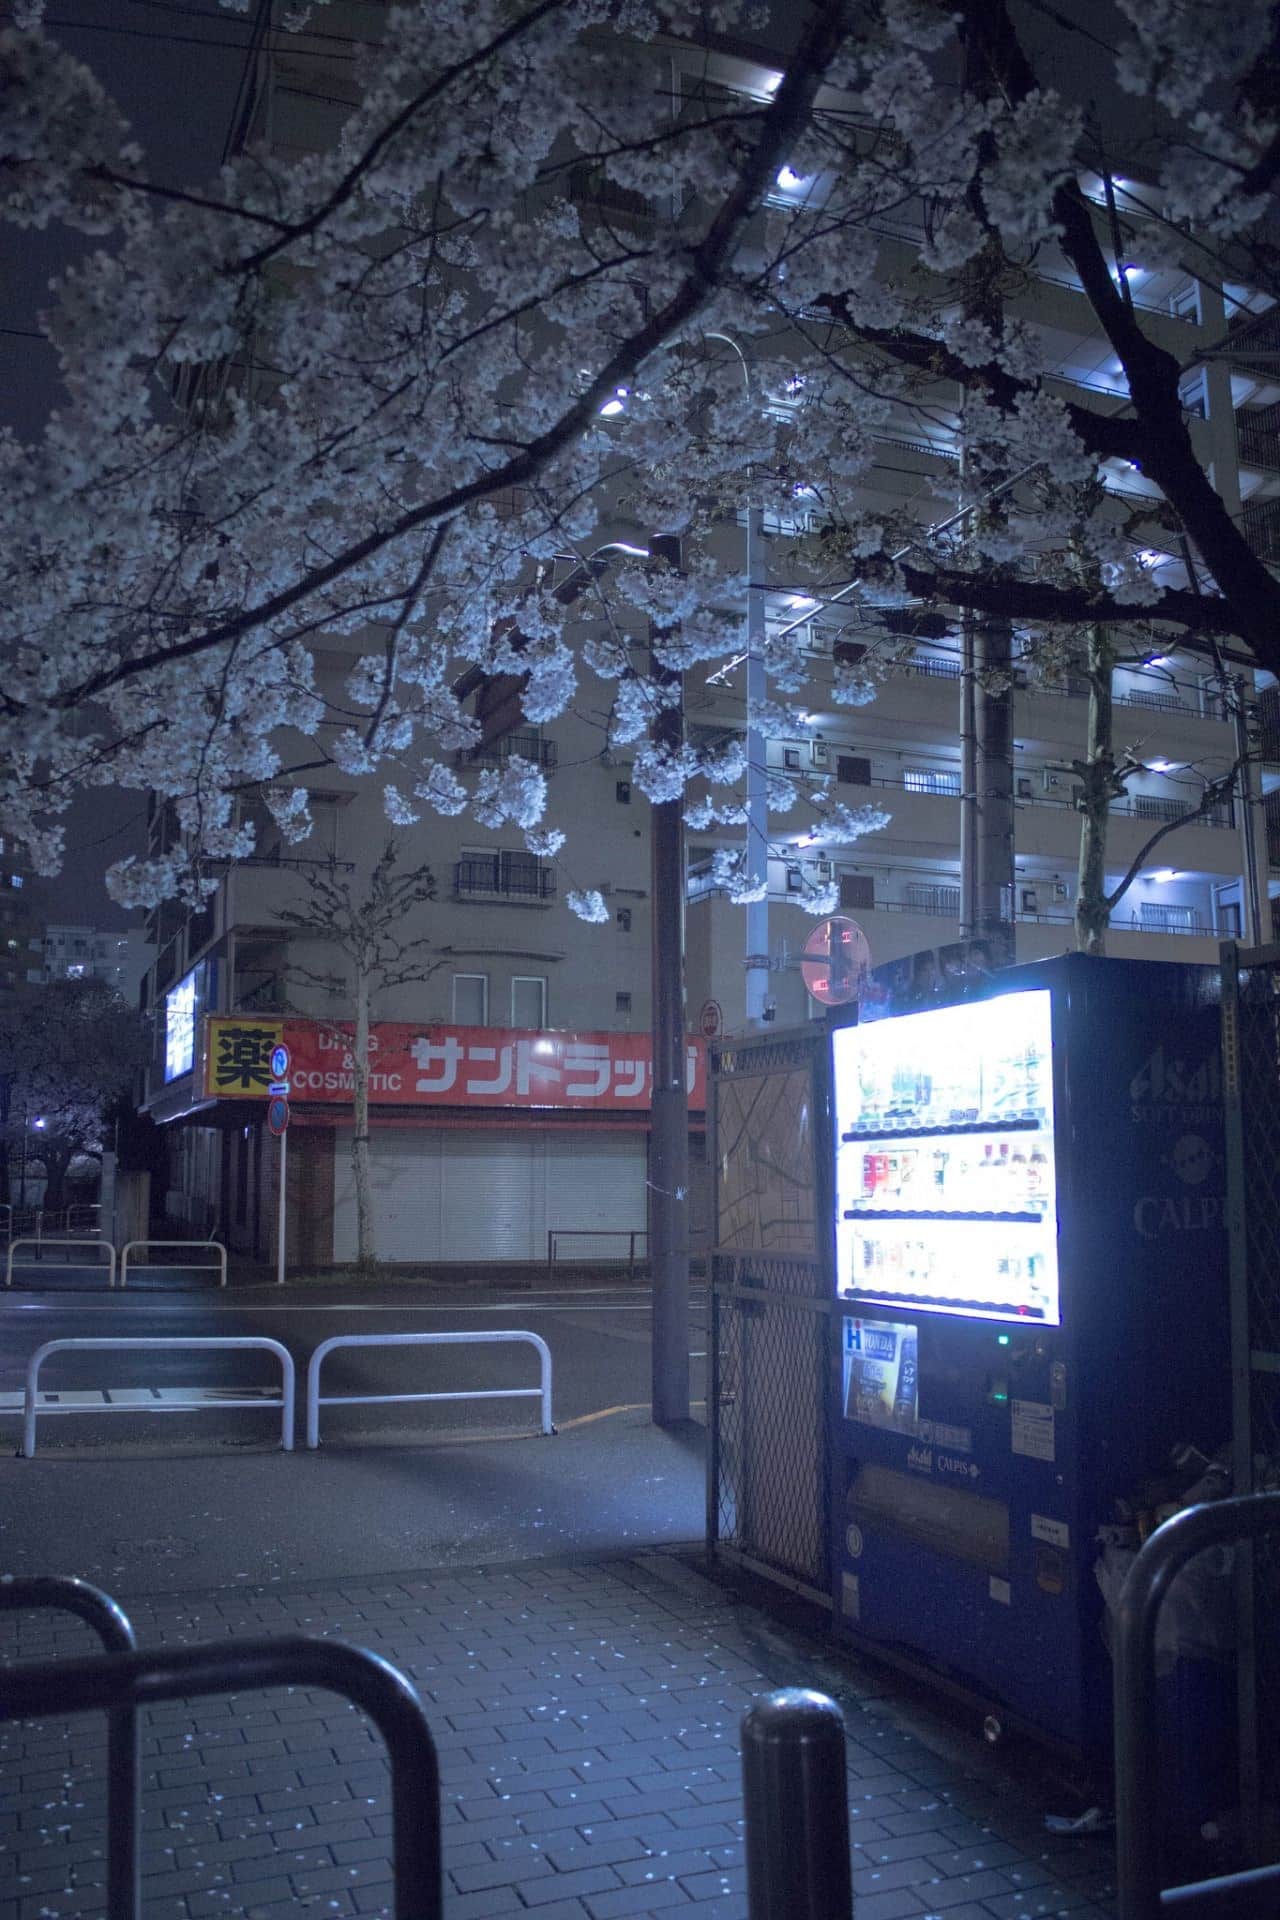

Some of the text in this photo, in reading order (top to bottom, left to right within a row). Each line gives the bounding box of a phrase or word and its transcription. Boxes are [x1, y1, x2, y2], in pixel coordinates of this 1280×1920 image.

[319, 1034, 379, 1051] DRG
[216, 1027, 276, 1089] 薬
[341, 1052, 355, 1070] &
[411, 1037, 697, 1097] サンドラッ
[292, 1071, 402, 1091] COSMTIC
